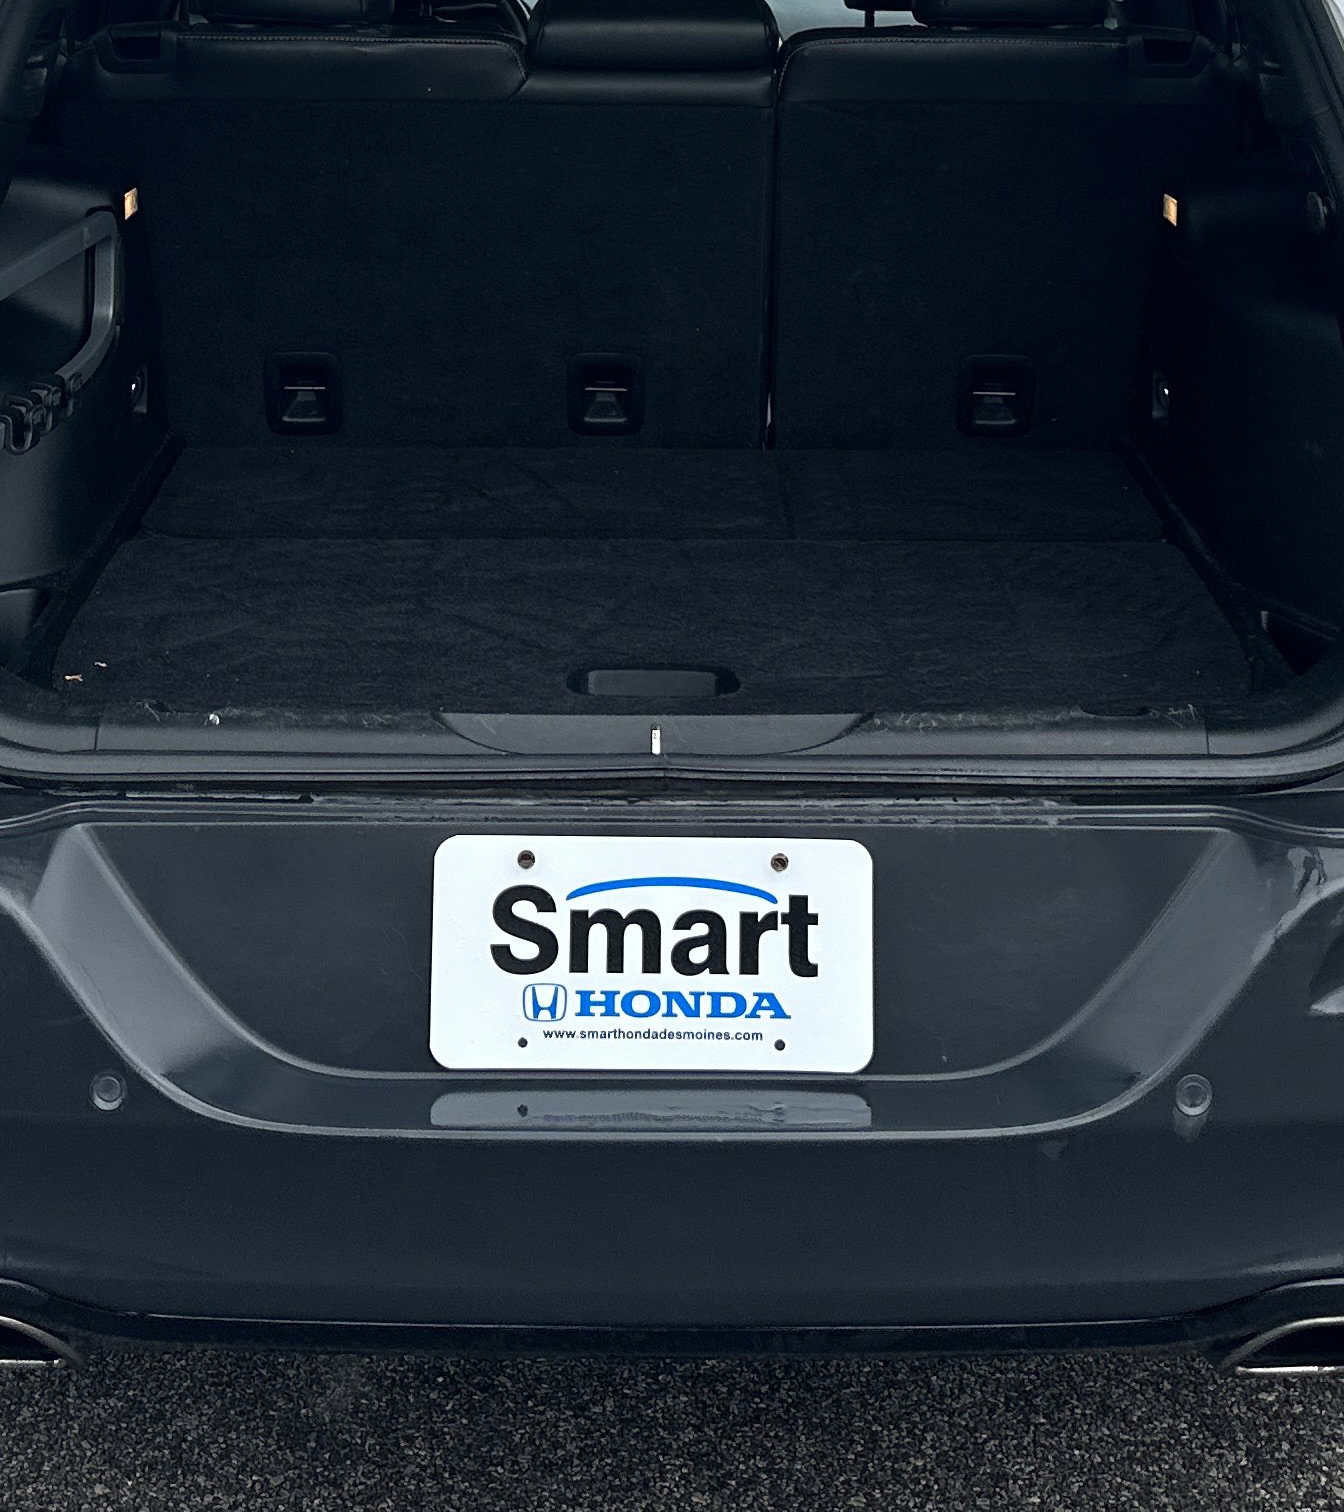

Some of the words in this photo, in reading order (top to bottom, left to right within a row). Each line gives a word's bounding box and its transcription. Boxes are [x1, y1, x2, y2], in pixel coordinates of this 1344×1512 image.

[490, 884, 819, 977] Smart
[574, 990, 792, 1019] HONDA
[542, 1027, 764, 1042] www.smarthondadesmoines.com
